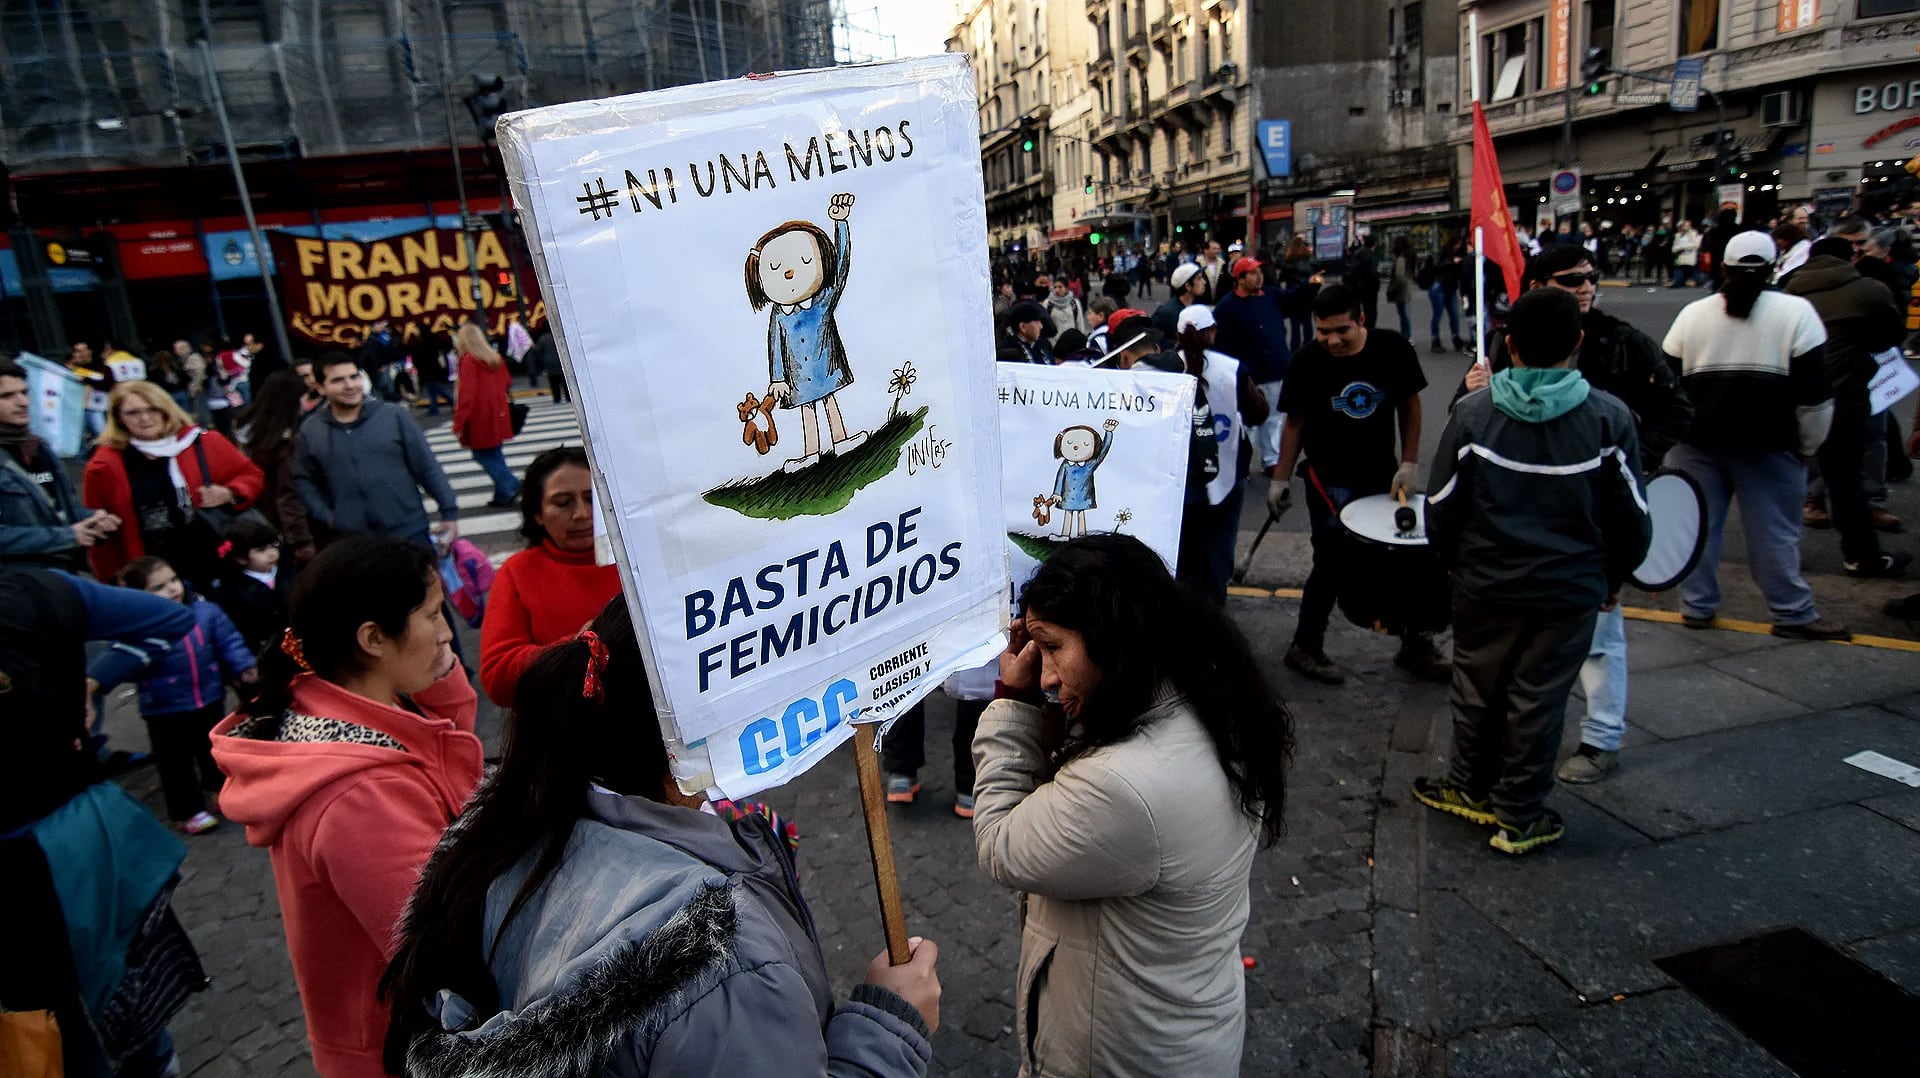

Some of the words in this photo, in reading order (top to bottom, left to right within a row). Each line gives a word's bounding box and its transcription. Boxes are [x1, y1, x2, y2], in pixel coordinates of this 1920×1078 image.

[1555, 0, 1569, 87] OSTEL
[575, 167, 678, 221] #NI
[688, 151, 777, 198] UNA
[783, 119, 914, 182] MENOS
[1267, 126, 1284, 147] E
[295, 229, 510, 280] FRANJA
[997, 386, 1035, 407] #NI
[1042, 389, 1080, 410] UNA
[1087, 391, 1156, 413] MENOS
[683, 539, 850, 641] BASTA
[866, 505, 922, 569] DE
[697, 541, 963, 694] FEMICIDIOS
[869, 641, 929, 681] CORRIENTE
[872, 664, 922, 701] CLASISTA
[924, 659, 933, 673] Y
[737, 677, 860, 776] CCC
